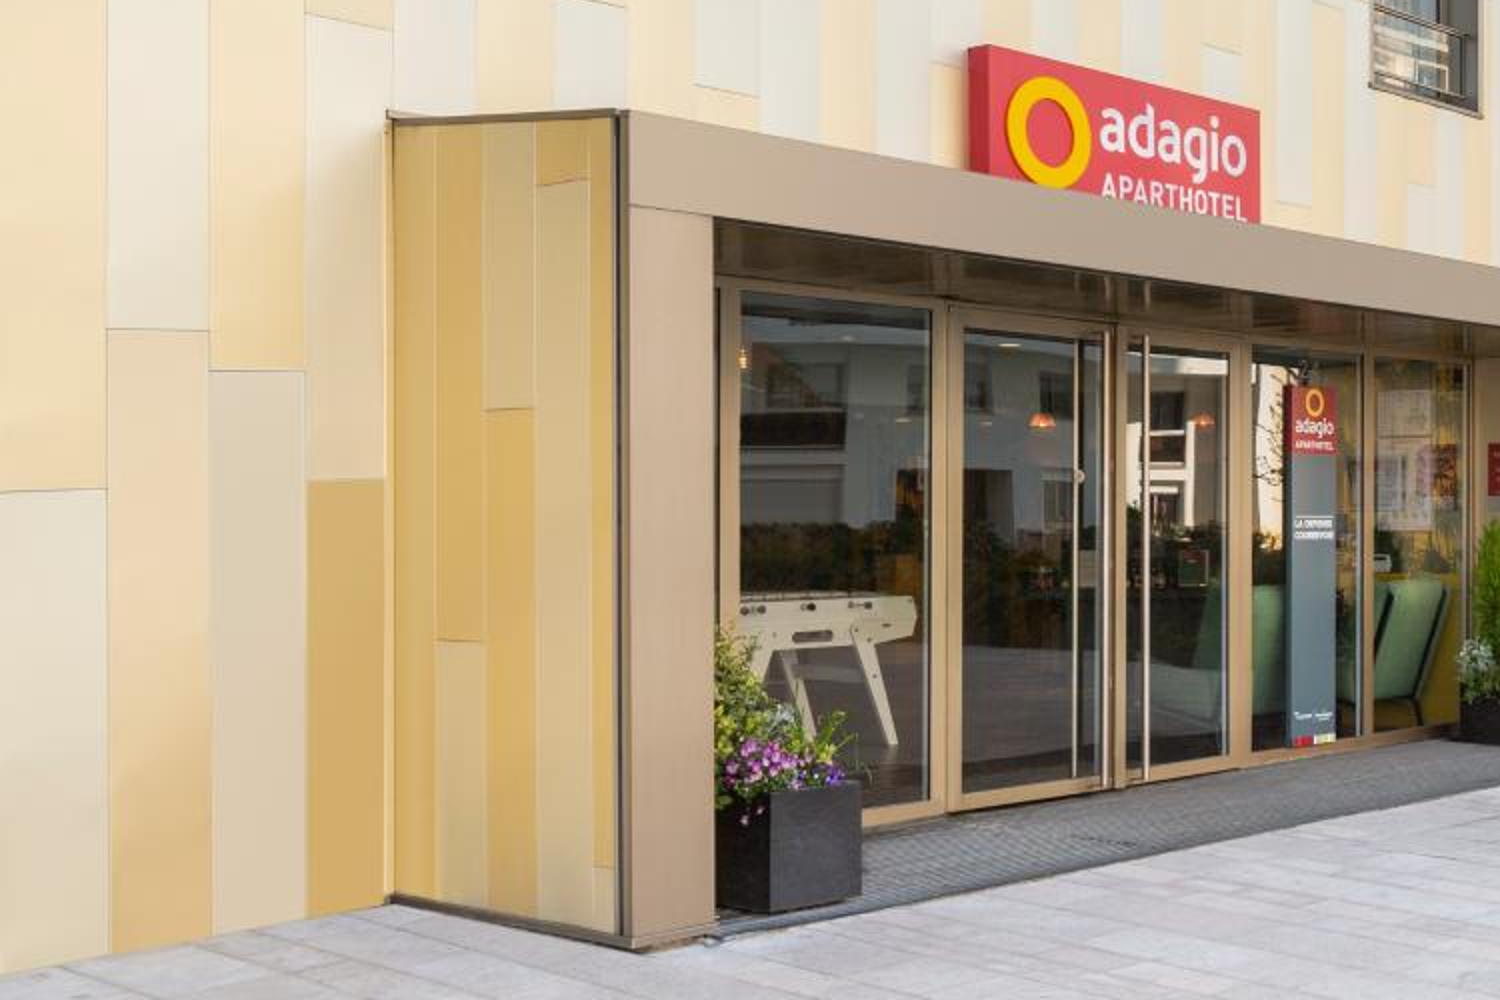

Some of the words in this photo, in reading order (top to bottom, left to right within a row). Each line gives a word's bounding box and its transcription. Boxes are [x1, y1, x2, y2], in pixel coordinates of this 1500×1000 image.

[1099, 103, 1247, 184] adagio
[1100, 172, 1248, 222] APARTHOTEL
[1295, 417, 1335, 439] adagio
